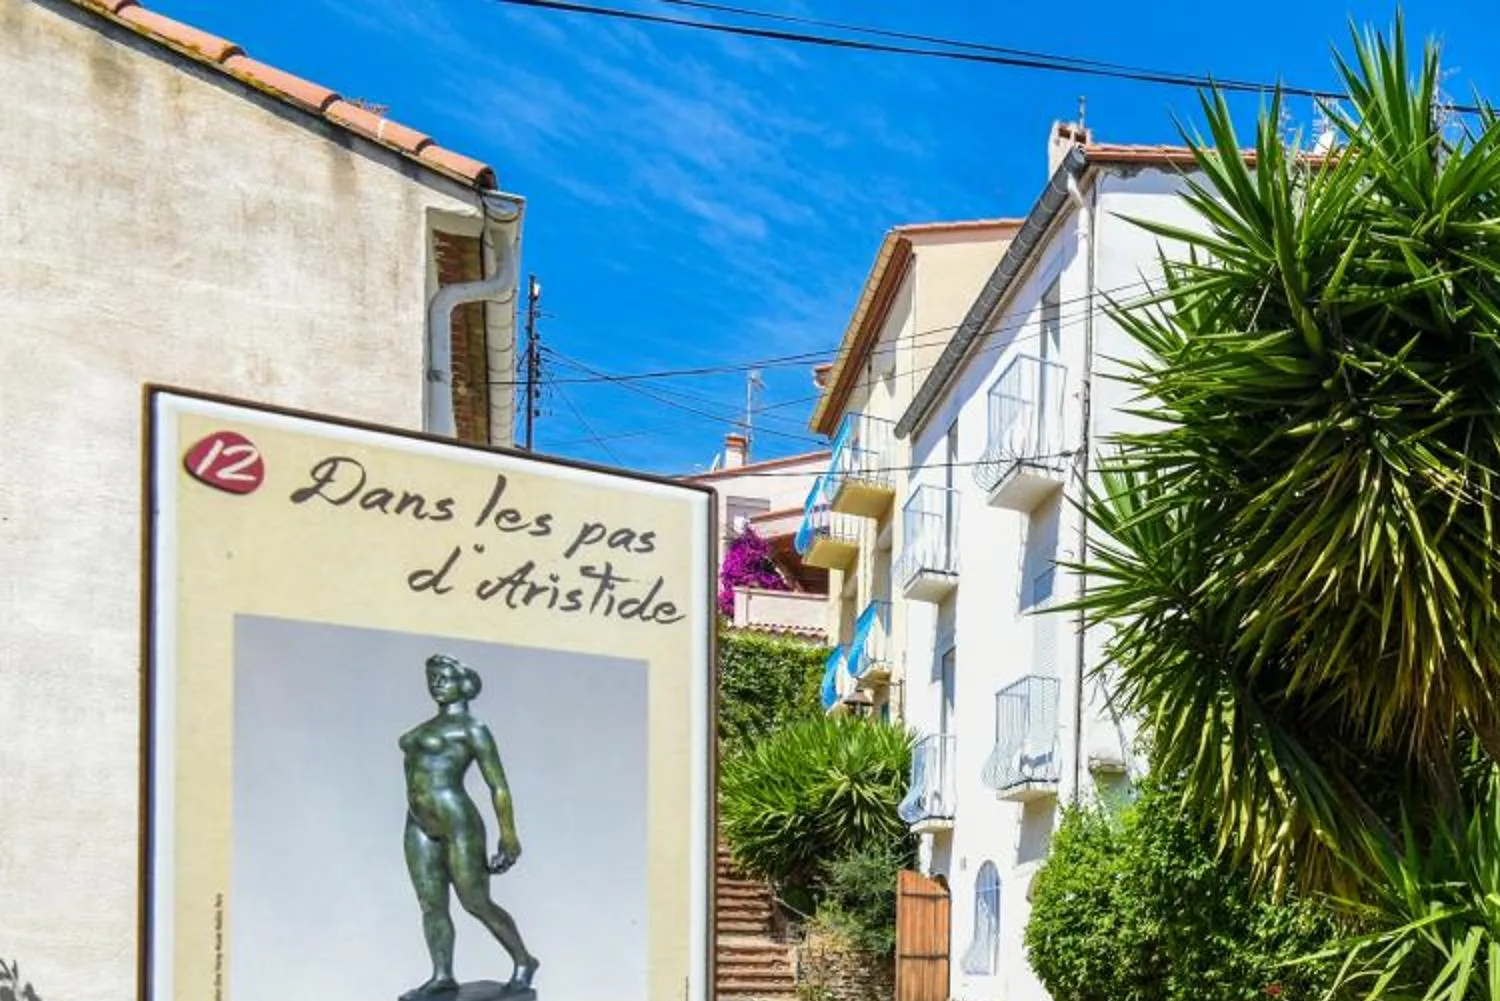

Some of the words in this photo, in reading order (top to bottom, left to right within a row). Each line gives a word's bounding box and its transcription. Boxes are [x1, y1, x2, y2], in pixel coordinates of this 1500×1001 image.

[196, 439, 258, 482] 12
[289, 455, 455, 522] Dans
[474, 473, 555, 537] les
[563, 522, 656, 559] pas
